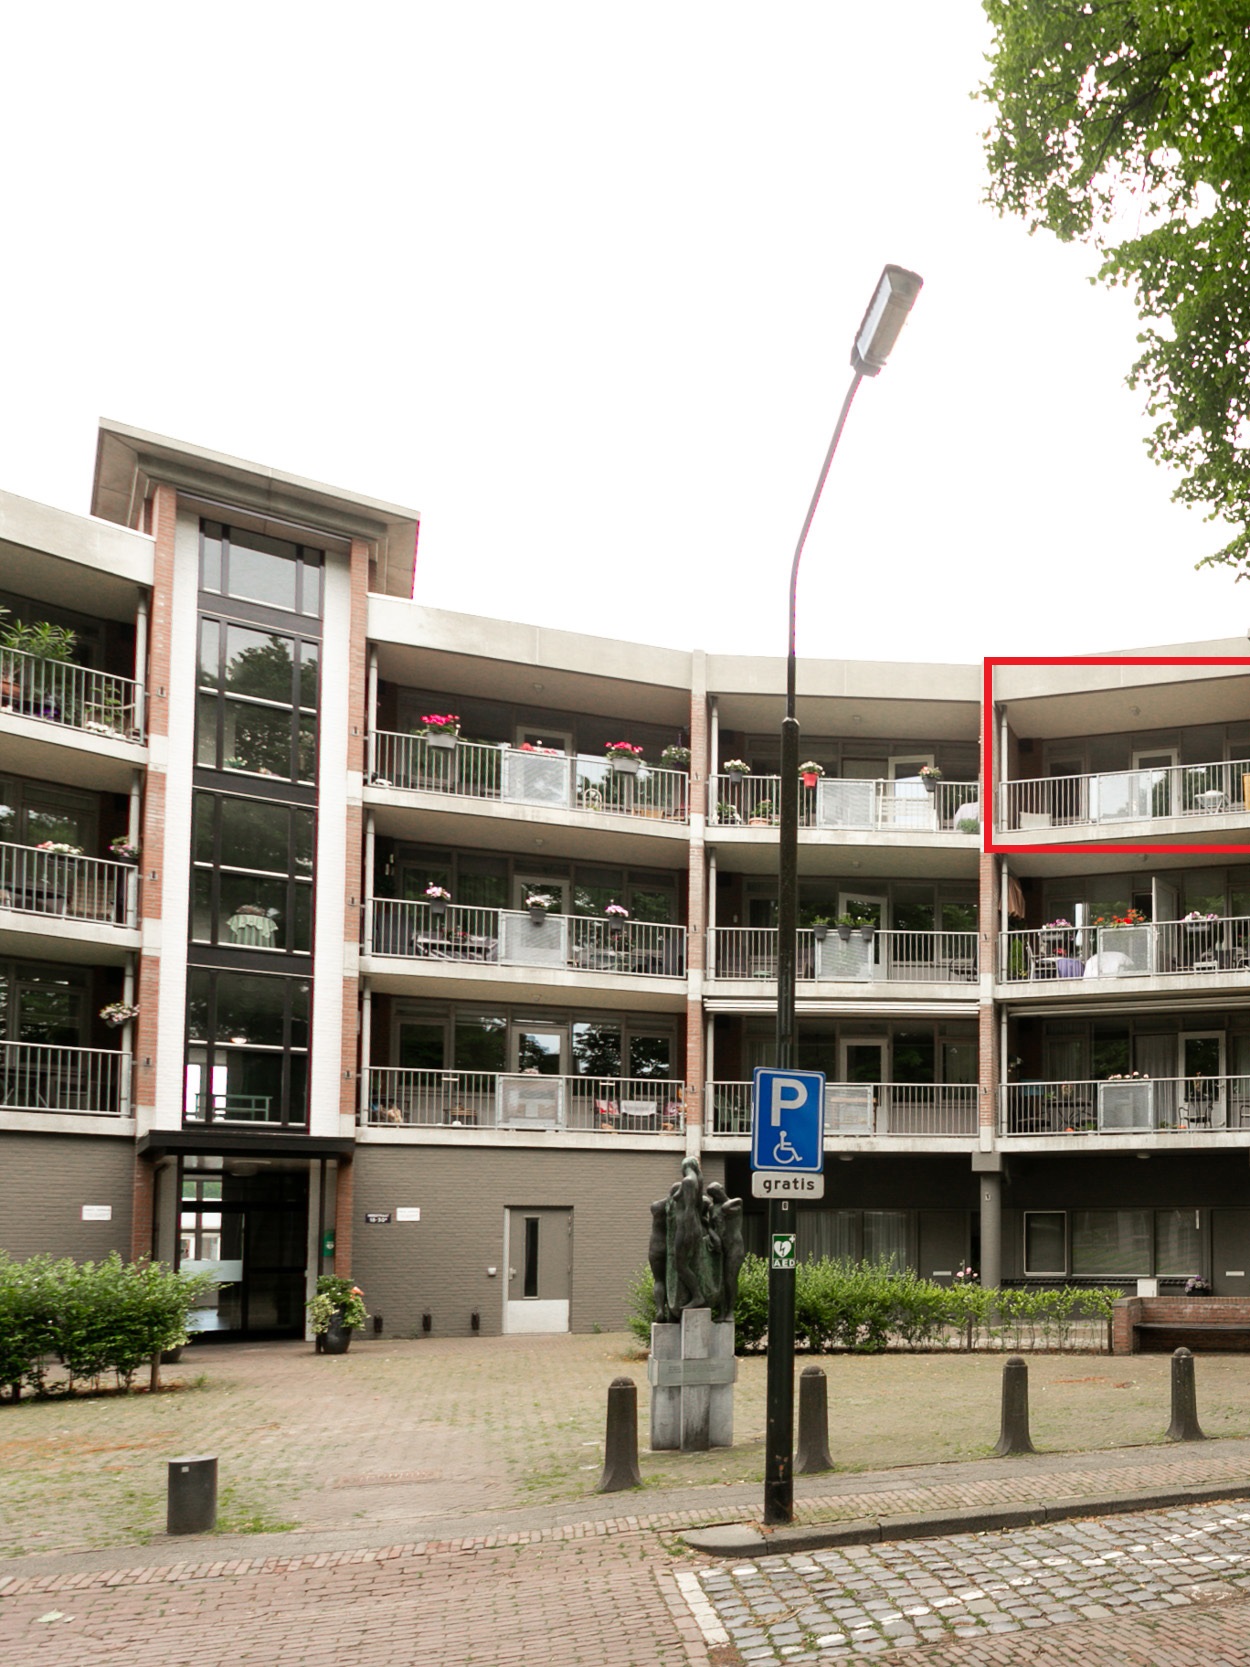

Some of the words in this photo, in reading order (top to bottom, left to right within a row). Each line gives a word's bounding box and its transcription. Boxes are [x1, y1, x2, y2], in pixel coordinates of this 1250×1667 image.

[771, 1077, 808, 1127] P
[763, 1178, 815, 1193] gratis
[774, 1259, 796, 1267] AED
